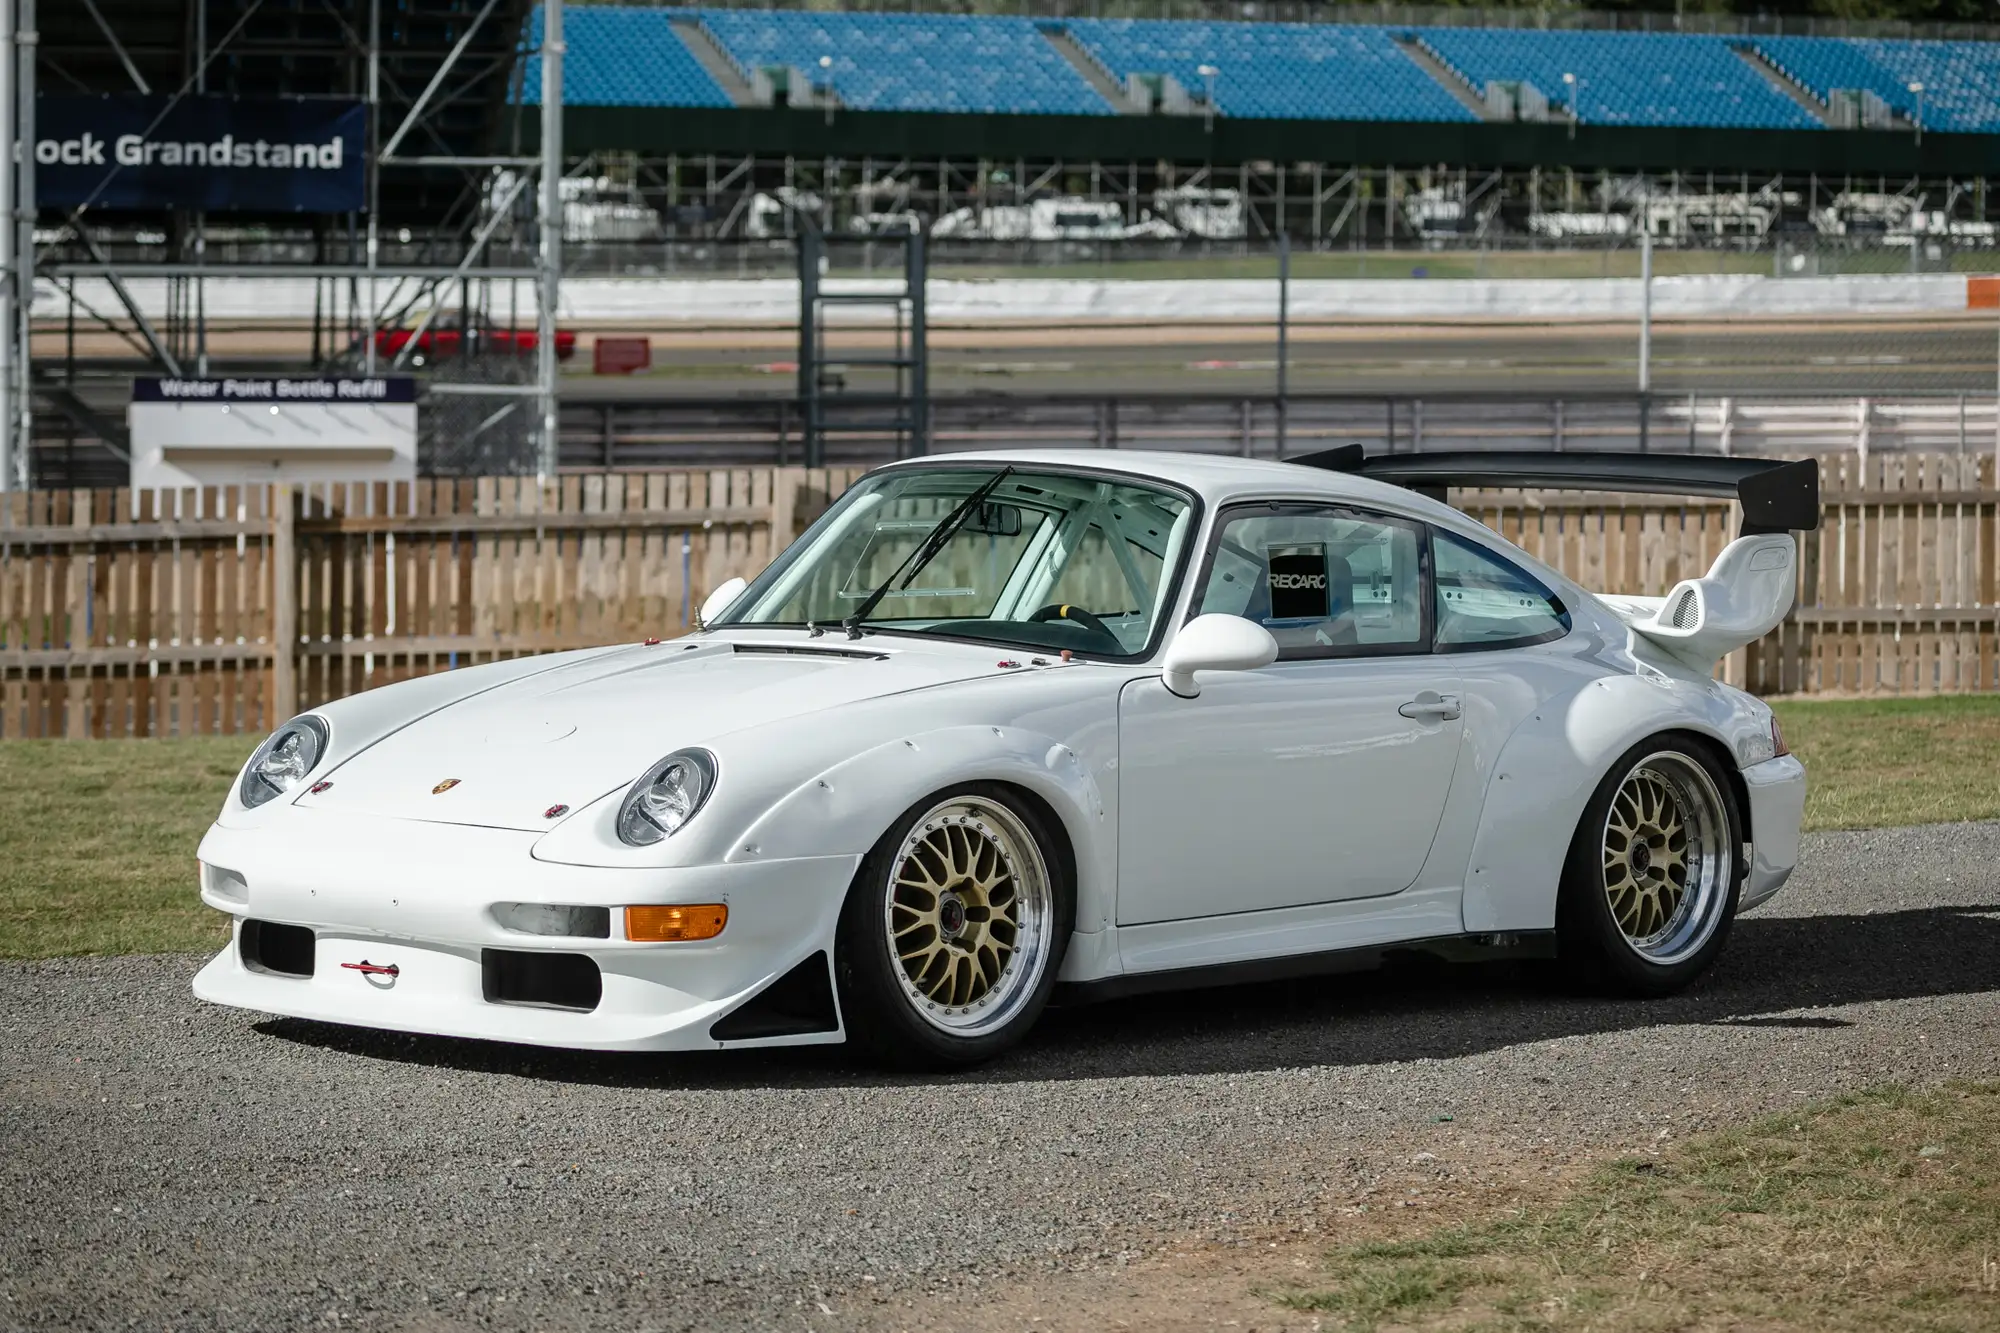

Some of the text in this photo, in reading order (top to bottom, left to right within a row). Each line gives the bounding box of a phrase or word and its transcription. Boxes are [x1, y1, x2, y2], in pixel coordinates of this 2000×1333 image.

[115, 134, 343, 169] Grandstand
[160, 379, 387, 397] Water Point Bottle Refill
